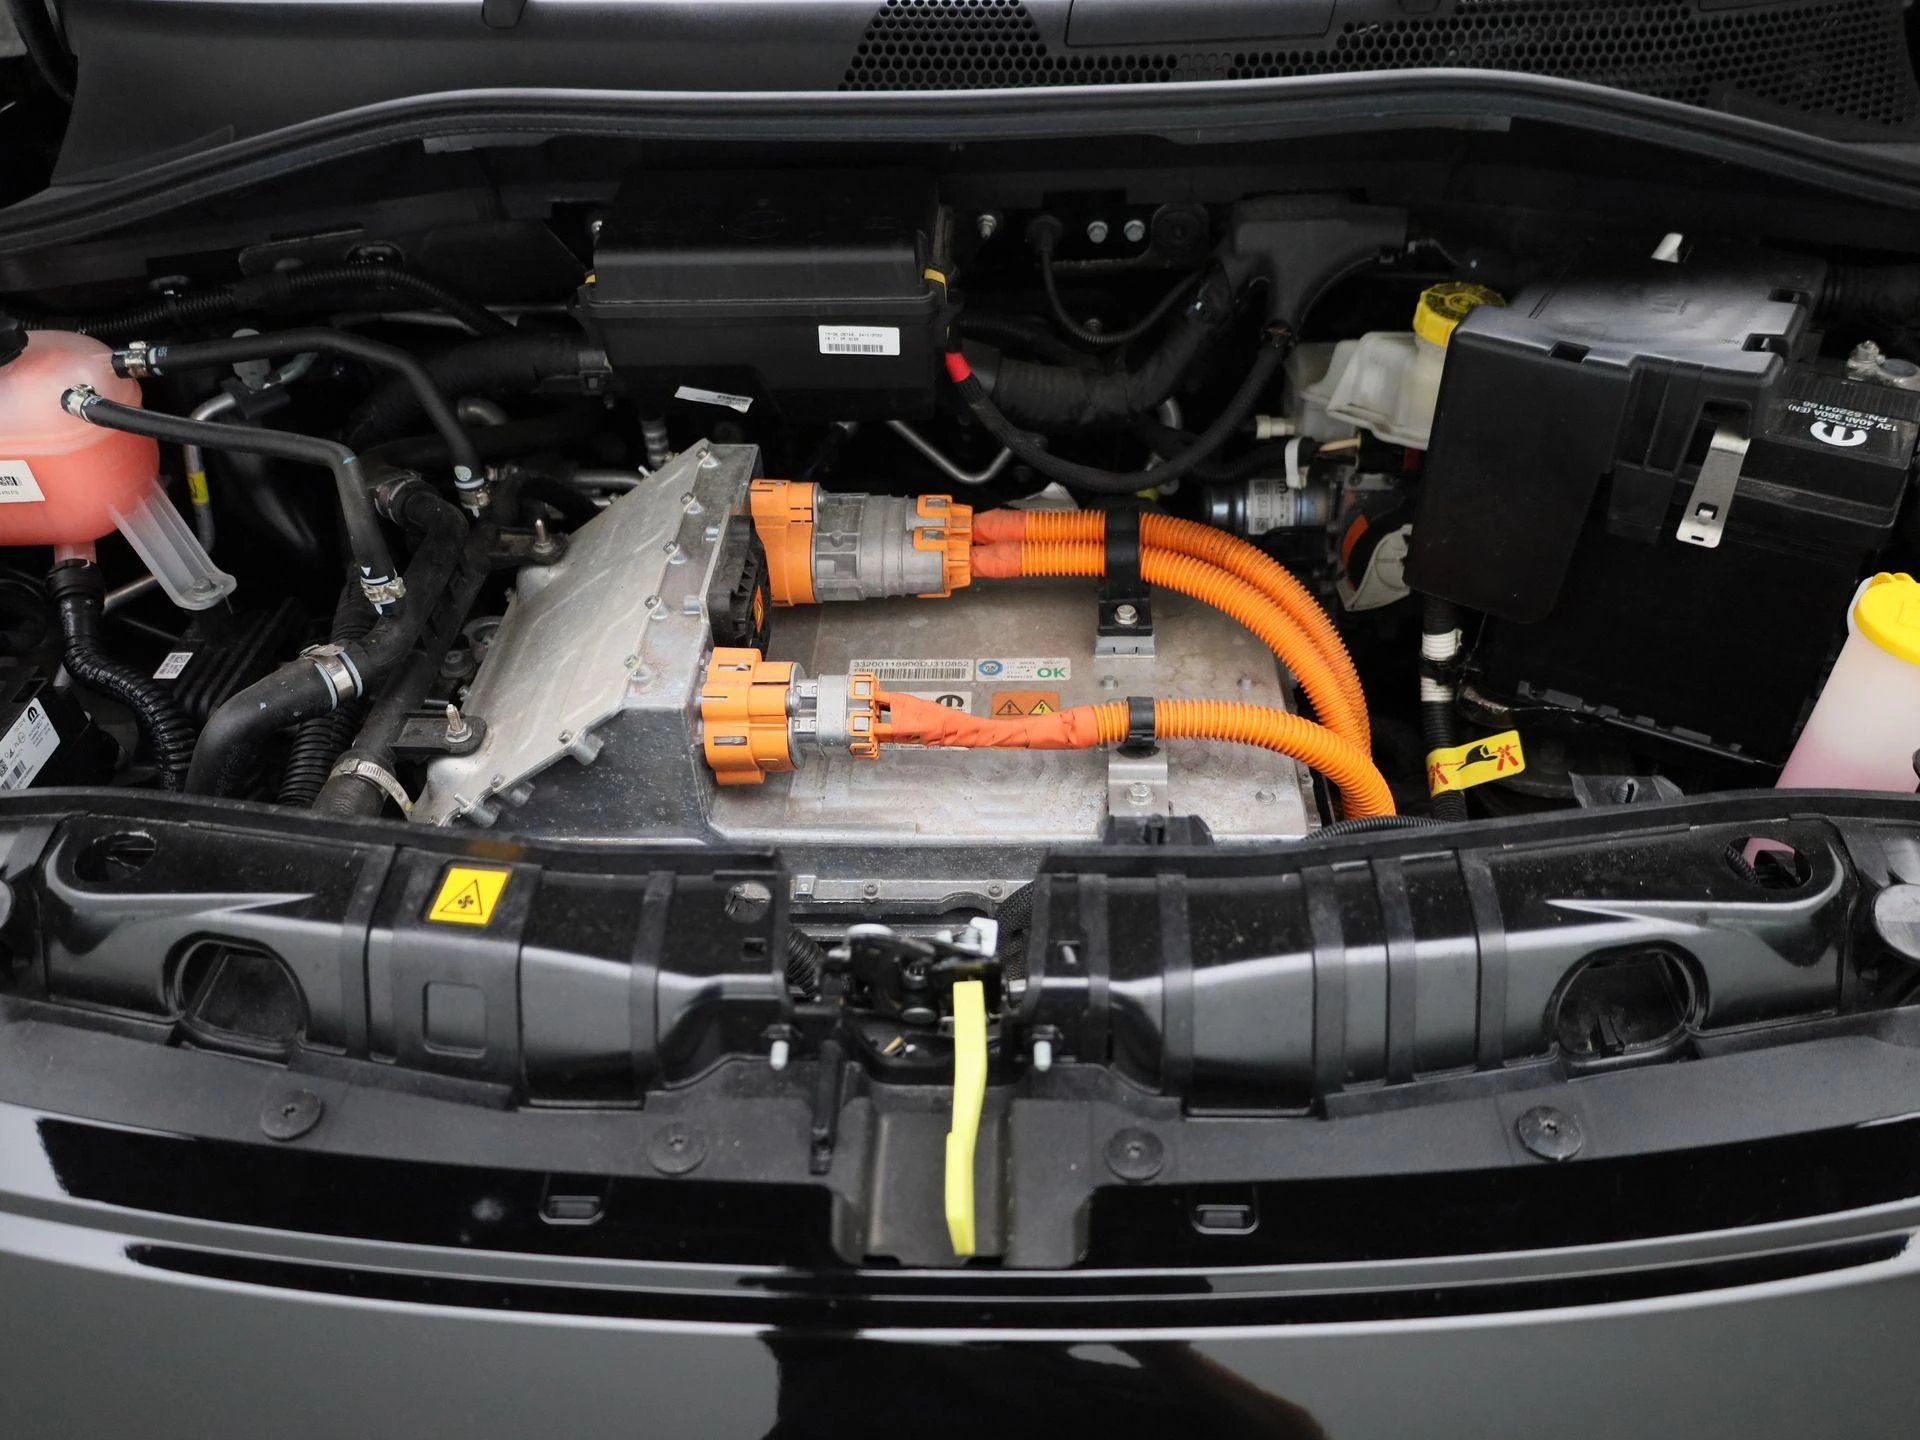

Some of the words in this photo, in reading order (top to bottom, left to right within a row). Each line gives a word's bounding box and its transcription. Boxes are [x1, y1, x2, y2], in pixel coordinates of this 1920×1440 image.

[1813, 409, 1842, 420] 360A
[1845, 416, 1874, 427] 40Ah
[1876, 422, 1898, 432] 12V
[1037, 667, 1066, 678] OK
